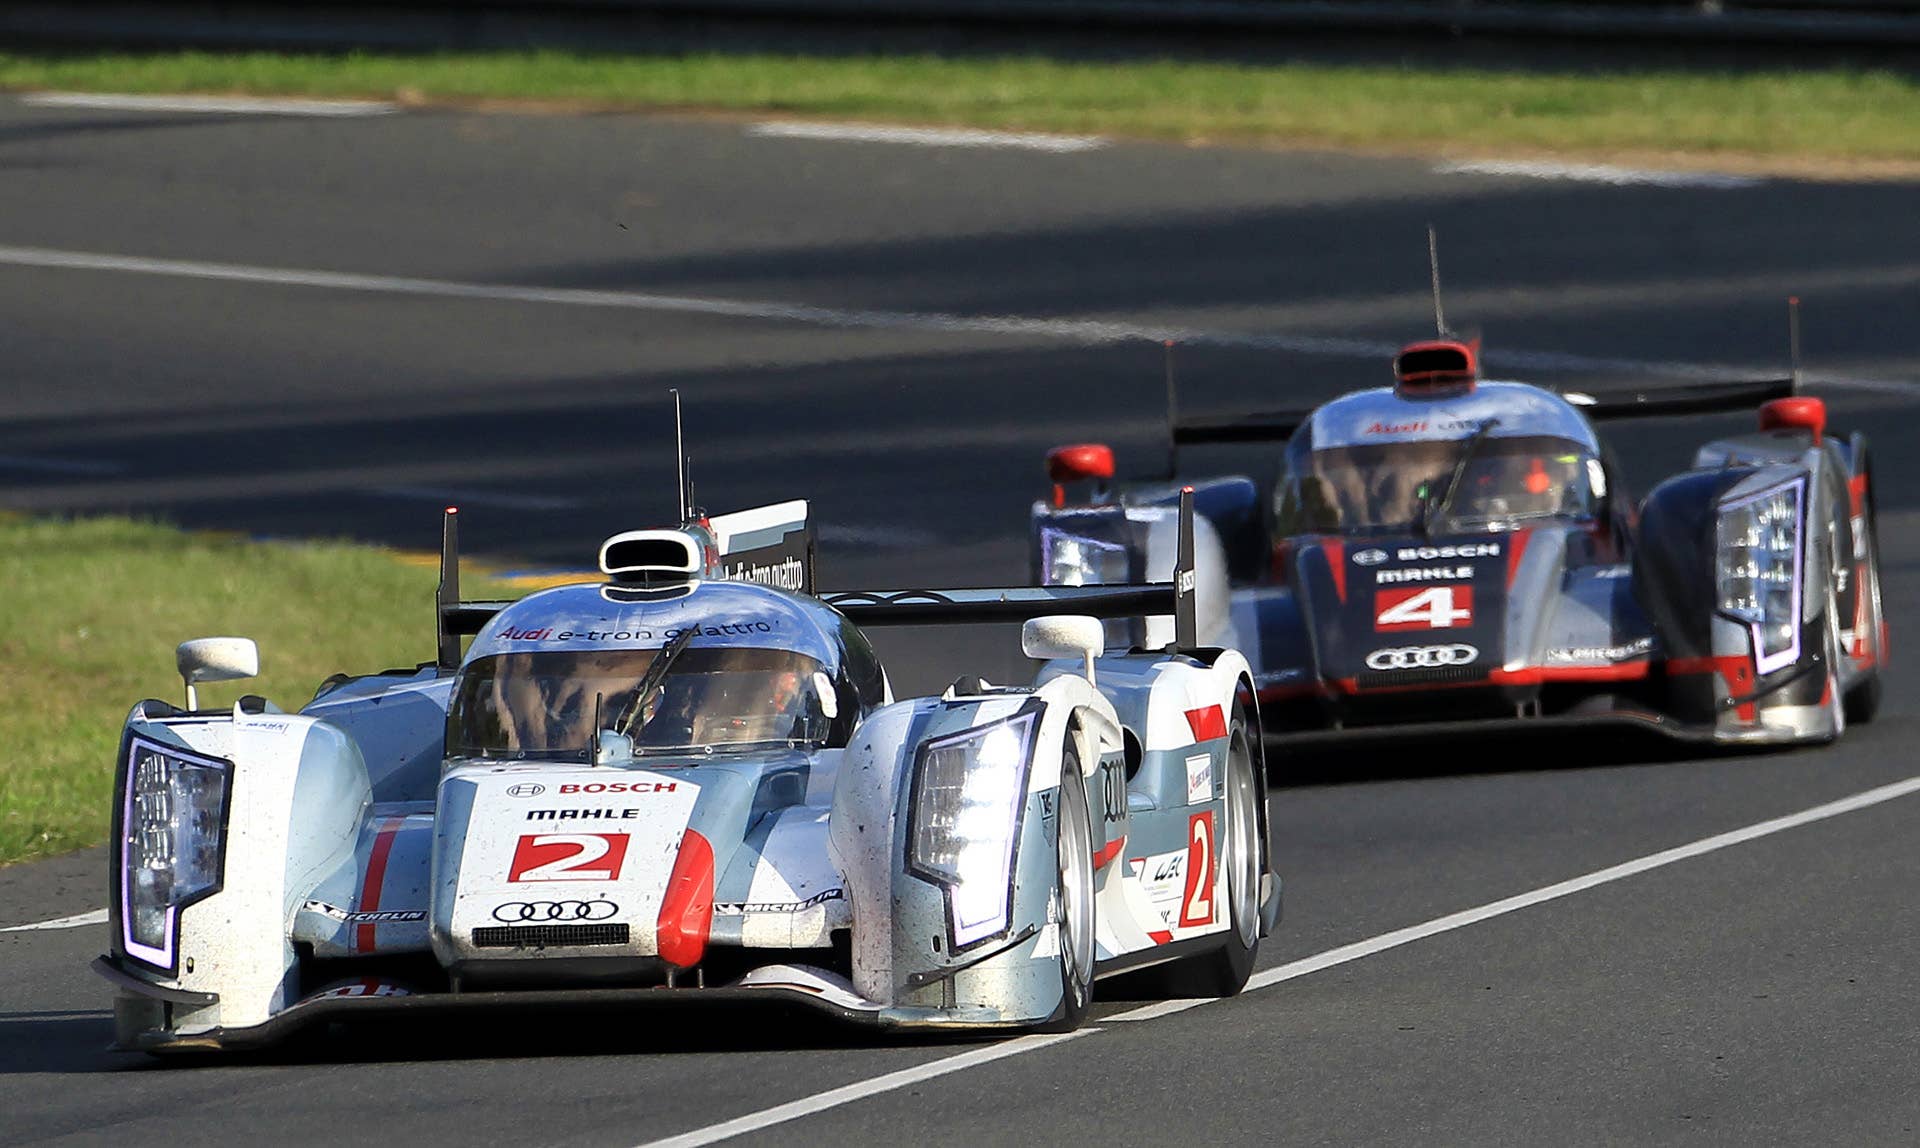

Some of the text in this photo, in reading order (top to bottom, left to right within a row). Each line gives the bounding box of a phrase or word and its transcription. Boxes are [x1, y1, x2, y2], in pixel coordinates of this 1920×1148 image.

[1397, 543, 1500, 561] BOSCH
[1376, 566, 1475, 584] MAHLE
[1377, 586, 1471, 628] 4
[495, 626, 553, 641] Audi
[557, 630, 652, 641] e-tron
[559, 783, 678, 794] BOSCH
[525, 808, 640, 821] MAHLE
[518, 834, 611, 881] 2
[1186, 819, 1211, 922] 2
[742, 889, 838, 912] MICHELIN
